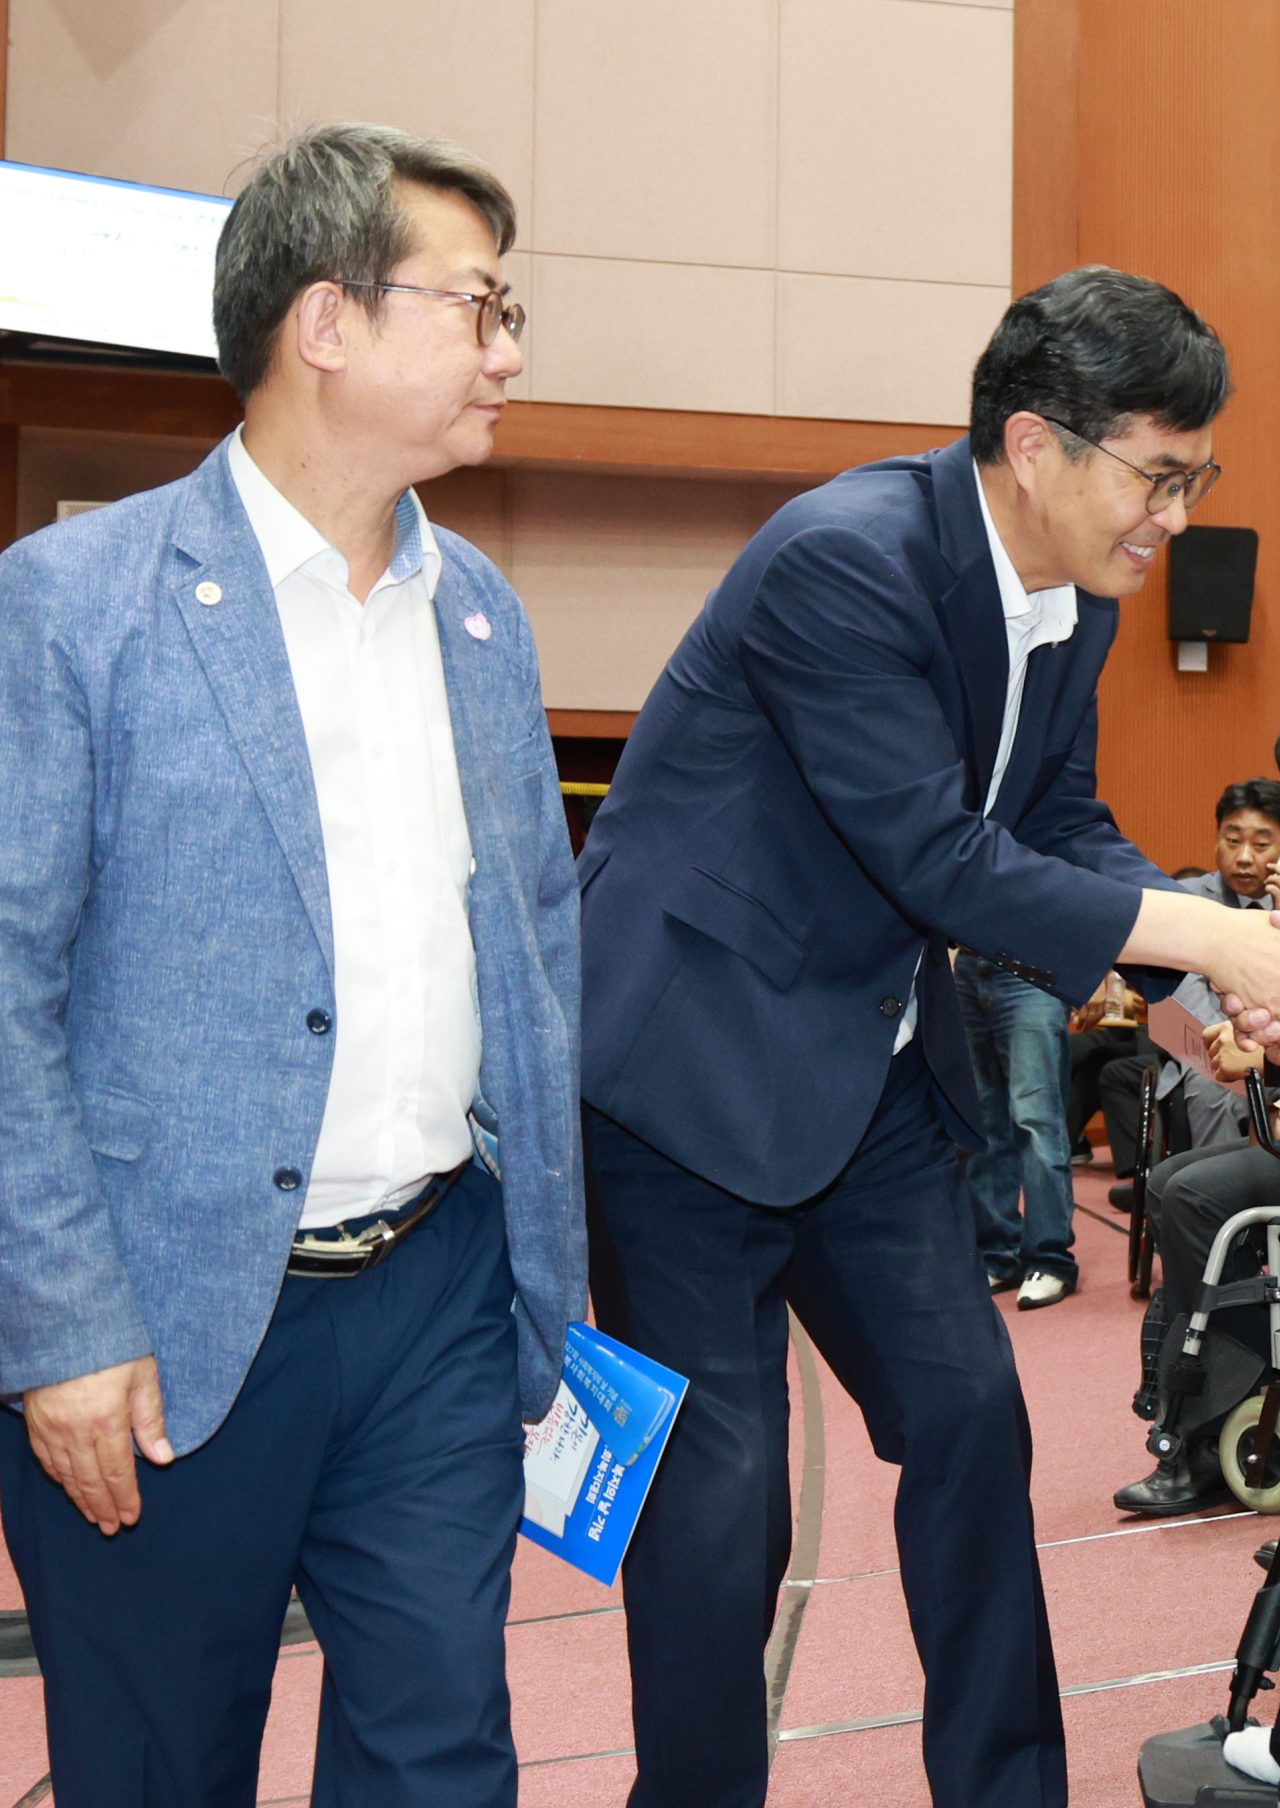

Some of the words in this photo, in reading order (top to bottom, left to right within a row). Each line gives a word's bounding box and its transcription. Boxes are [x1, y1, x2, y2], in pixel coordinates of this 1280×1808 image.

[585, 1445, 613, 1505] 회복지대회
[603, 1463, 625, 1501] 복지의
[597, 1499, 612, 1516] 날
[587, 1514, 607, 1542] 기념
